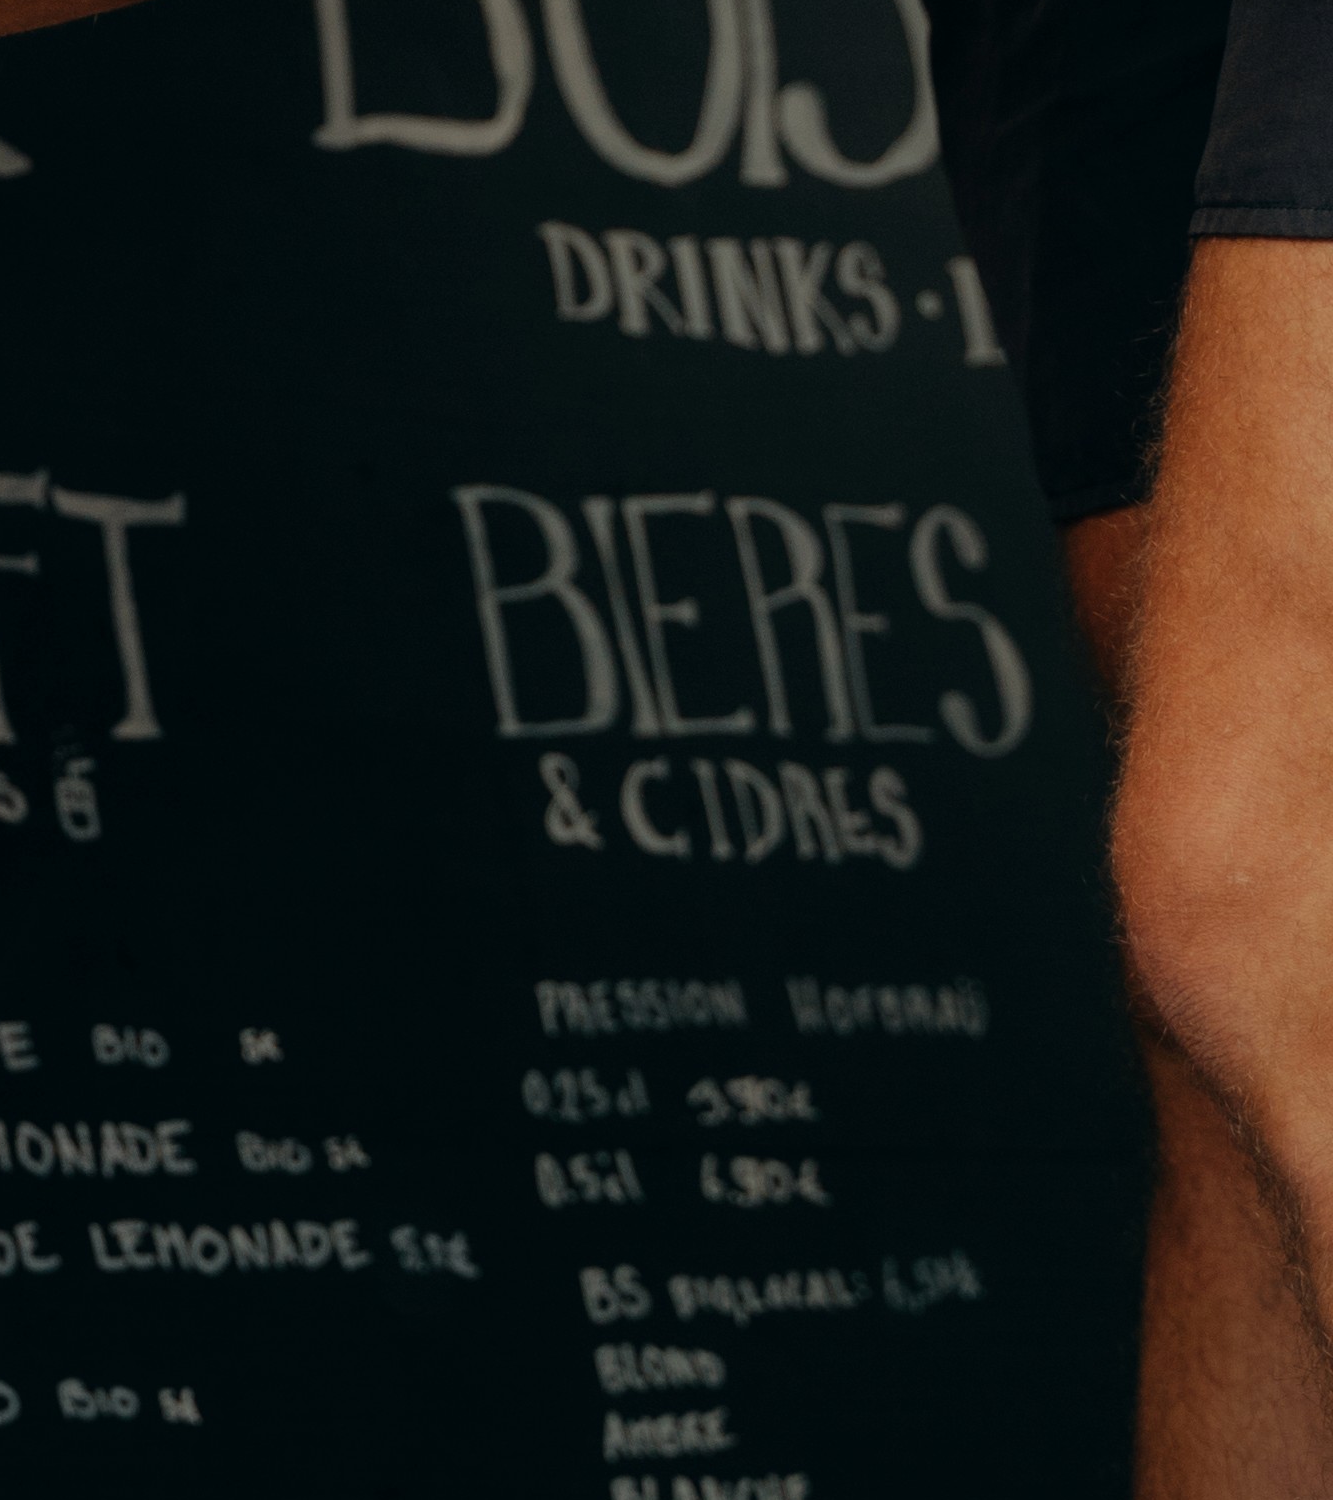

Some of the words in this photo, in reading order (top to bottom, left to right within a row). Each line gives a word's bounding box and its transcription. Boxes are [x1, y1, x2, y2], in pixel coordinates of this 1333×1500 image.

[541, 221, 902, 354] DRINKS
[453, 482, 1036, 757] BIERES
[540, 754, 603, 848] &
[620, 758, 923, 869] CIDRES
[88, 1218, 372, 1277] LEMONADE
